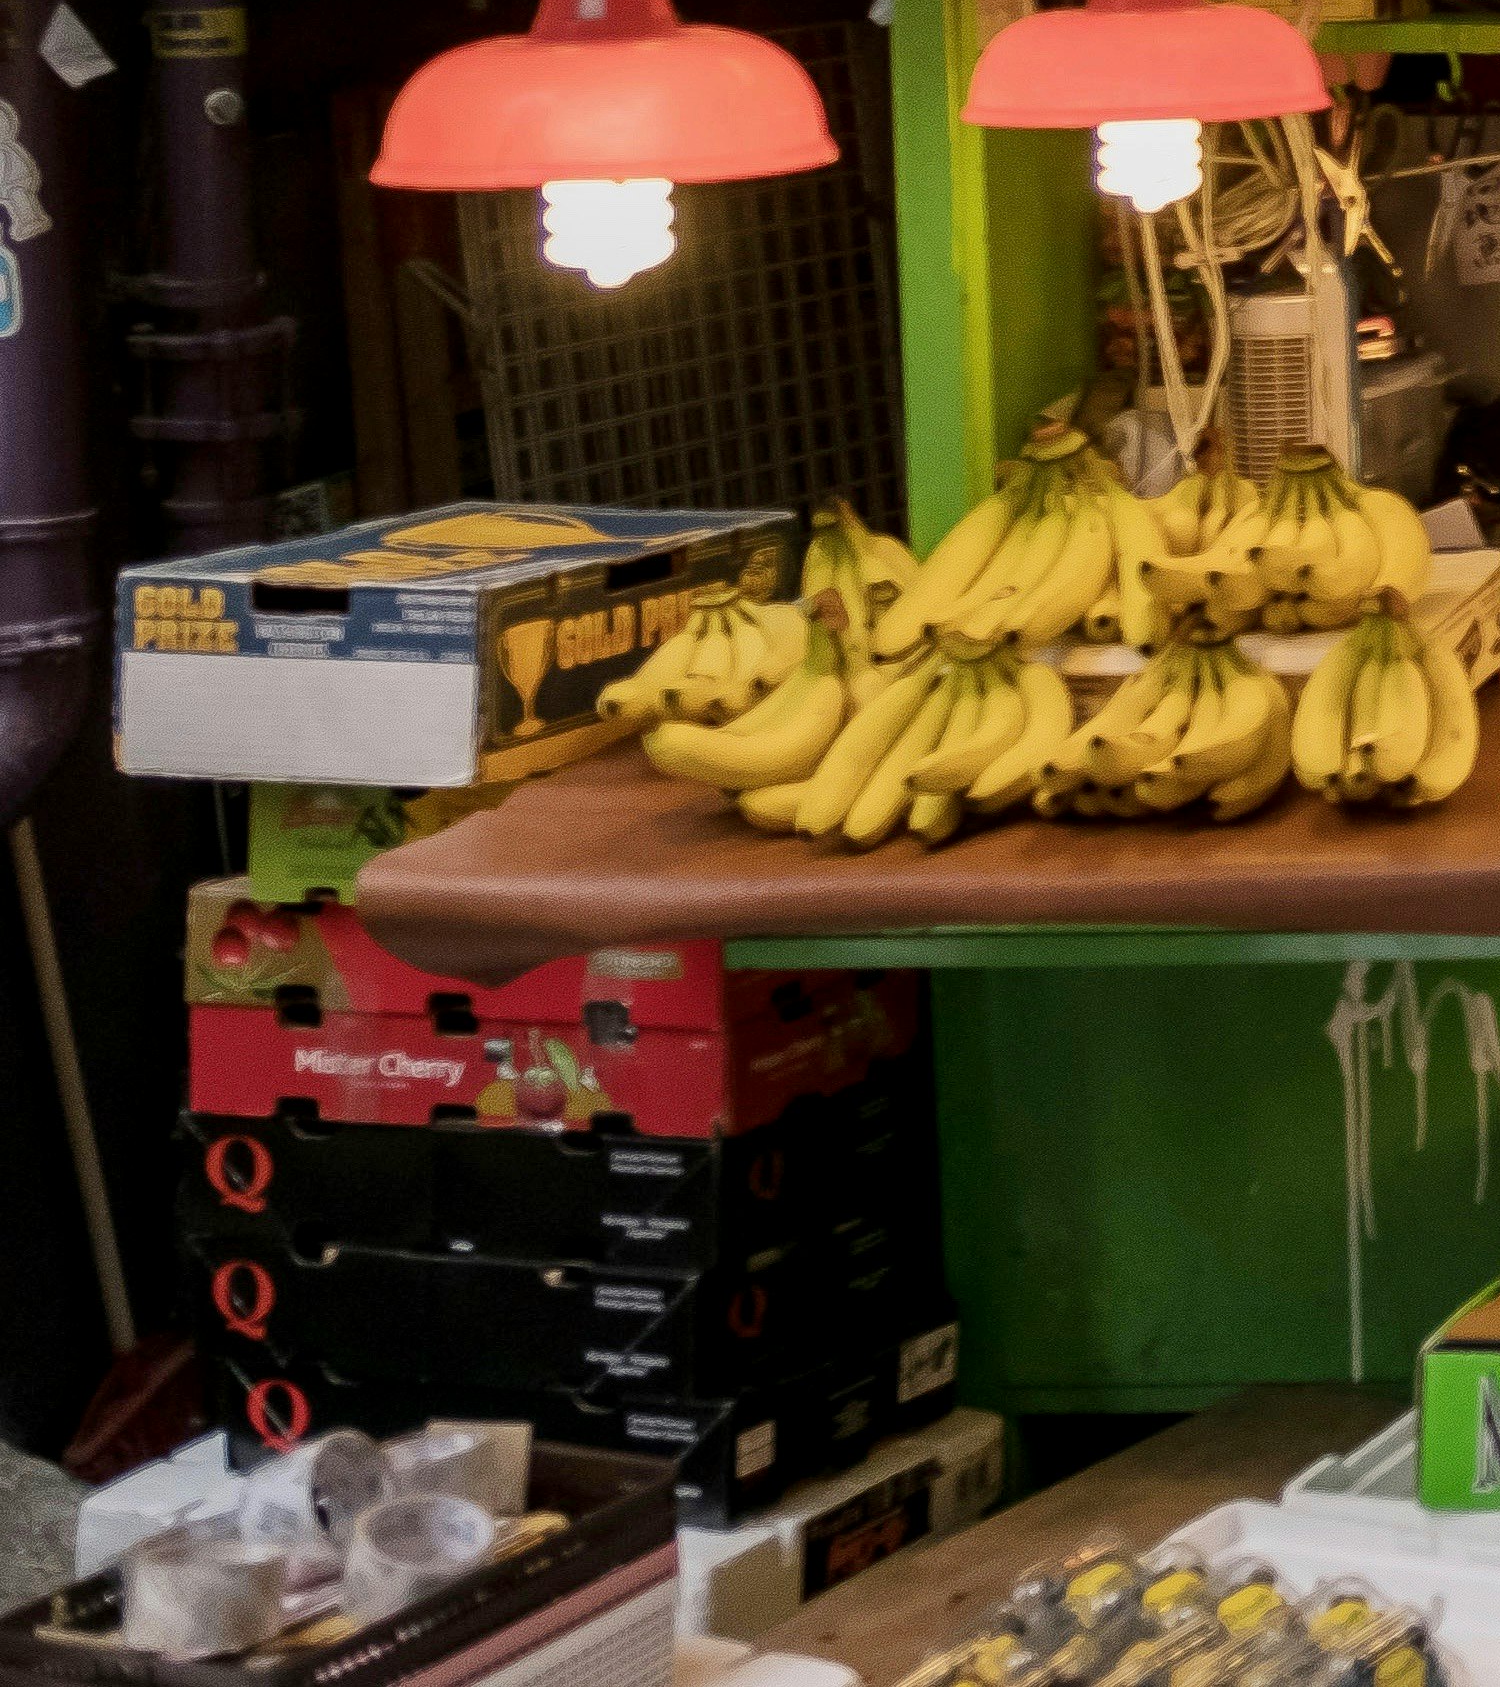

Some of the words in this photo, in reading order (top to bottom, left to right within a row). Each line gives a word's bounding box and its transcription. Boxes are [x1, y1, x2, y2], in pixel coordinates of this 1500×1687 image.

[133, 585, 225, 620] GOLD
[134, 620, 239, 654] PRIZE
[378, 1052, 467, 1088] Cherry
[206, 1135, 273, 1213] Q
[212, 1260, 275, 1341] Q
